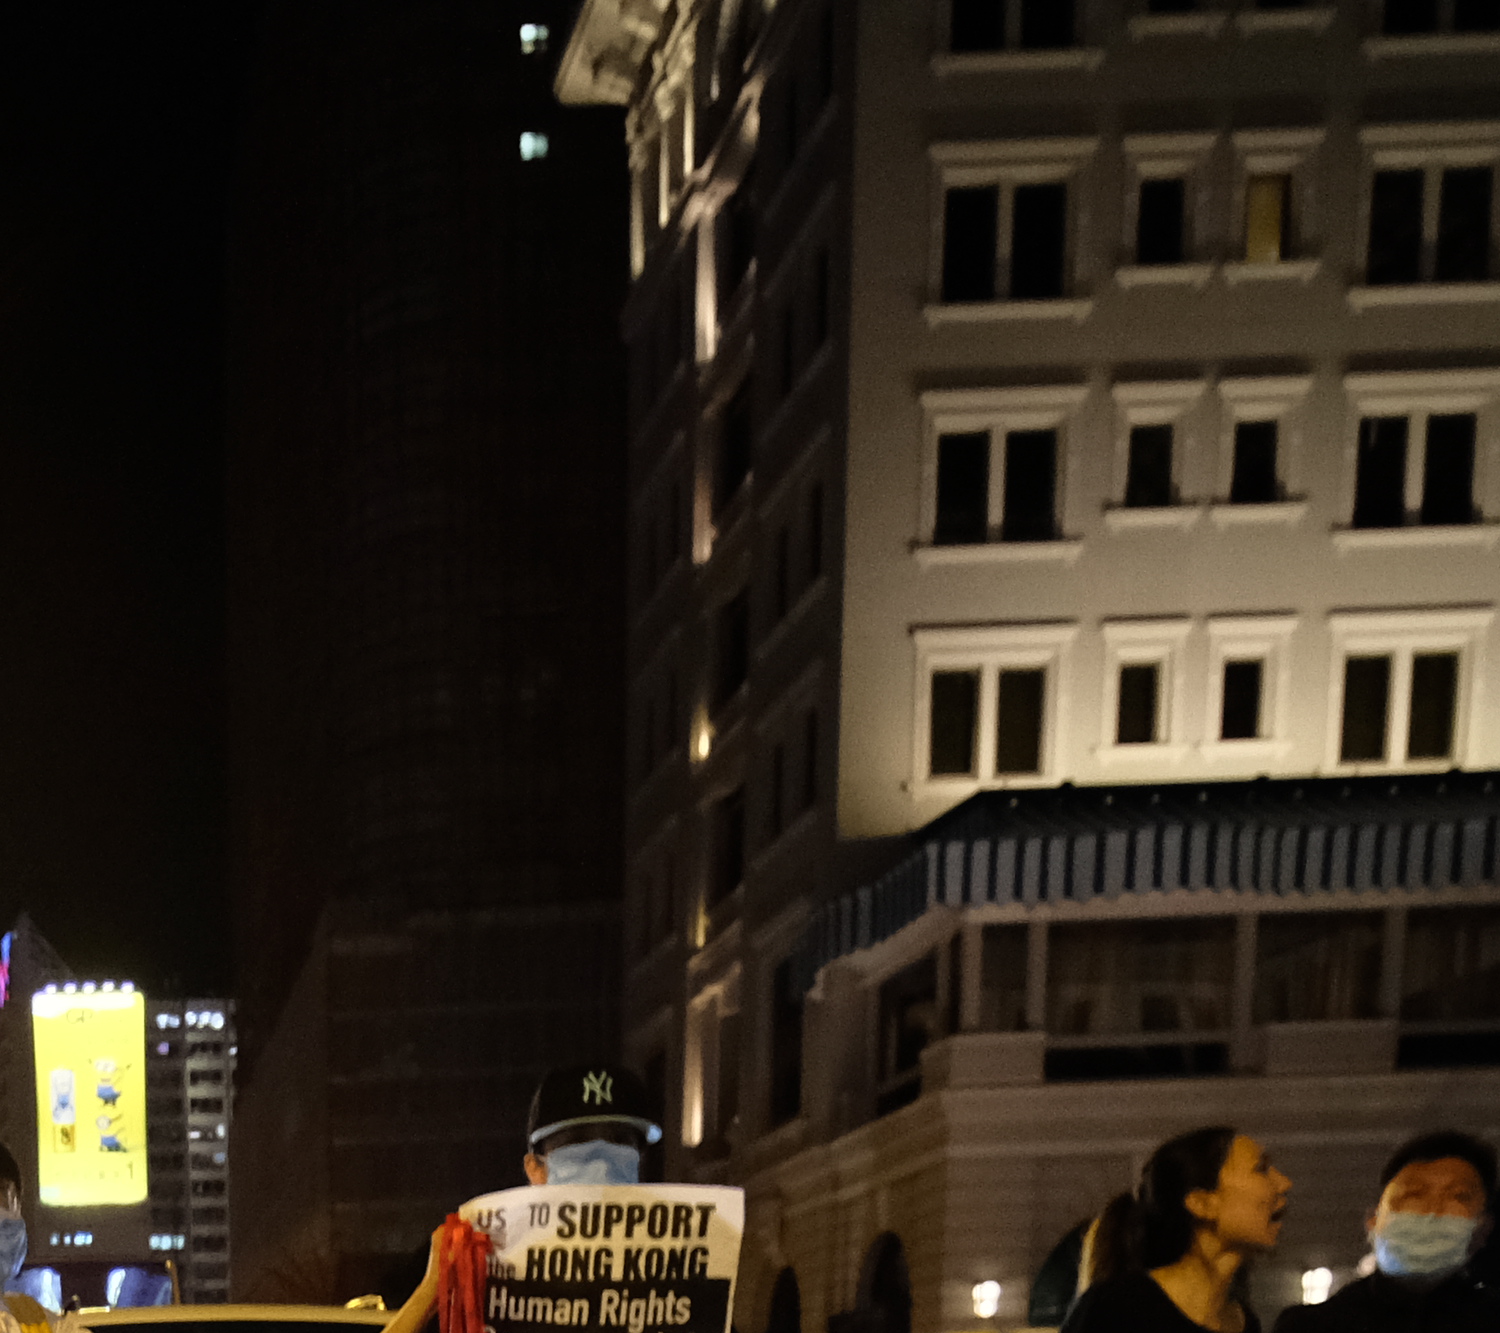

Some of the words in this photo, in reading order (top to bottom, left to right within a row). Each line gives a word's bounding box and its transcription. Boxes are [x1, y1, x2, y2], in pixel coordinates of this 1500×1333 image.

[583, 1070, 614, 1105] NY
[476, 1207, 507, 1231] US
[528, 1201, 550, 1228] TO
[556, 1201, 717, 1240] SUPPORT
[525, 1245, 614, 1282] HONG
[621, 1246, 710, 1282] KONG
[488, 1286, 590, 1327] Human
